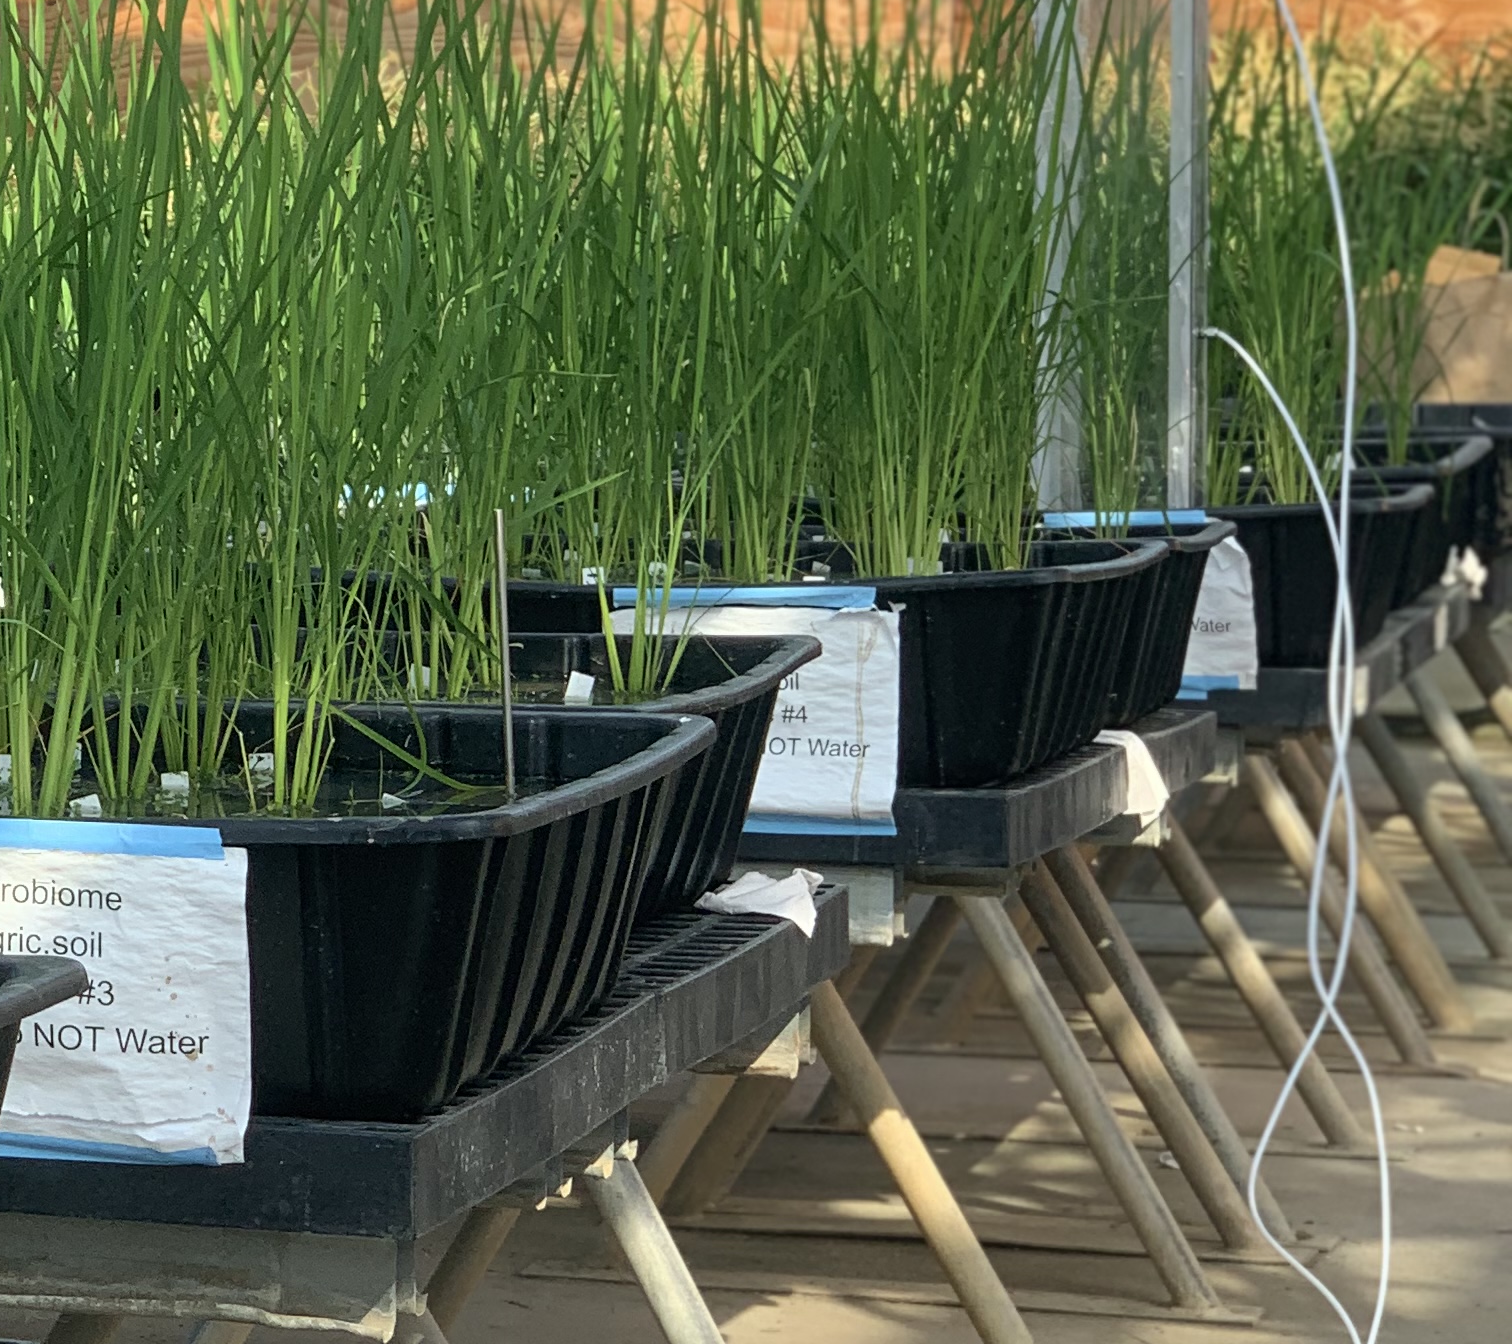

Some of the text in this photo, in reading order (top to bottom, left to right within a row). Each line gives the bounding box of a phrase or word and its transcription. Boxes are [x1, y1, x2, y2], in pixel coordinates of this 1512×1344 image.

[781, 704, 808, 724] #4
[767, 736, 871, 758] OT Water
[77, 979, 115, 1006] #3
[34, 1022, 105, 1052] NOT
[115, 1027, 210, 1055] Water
